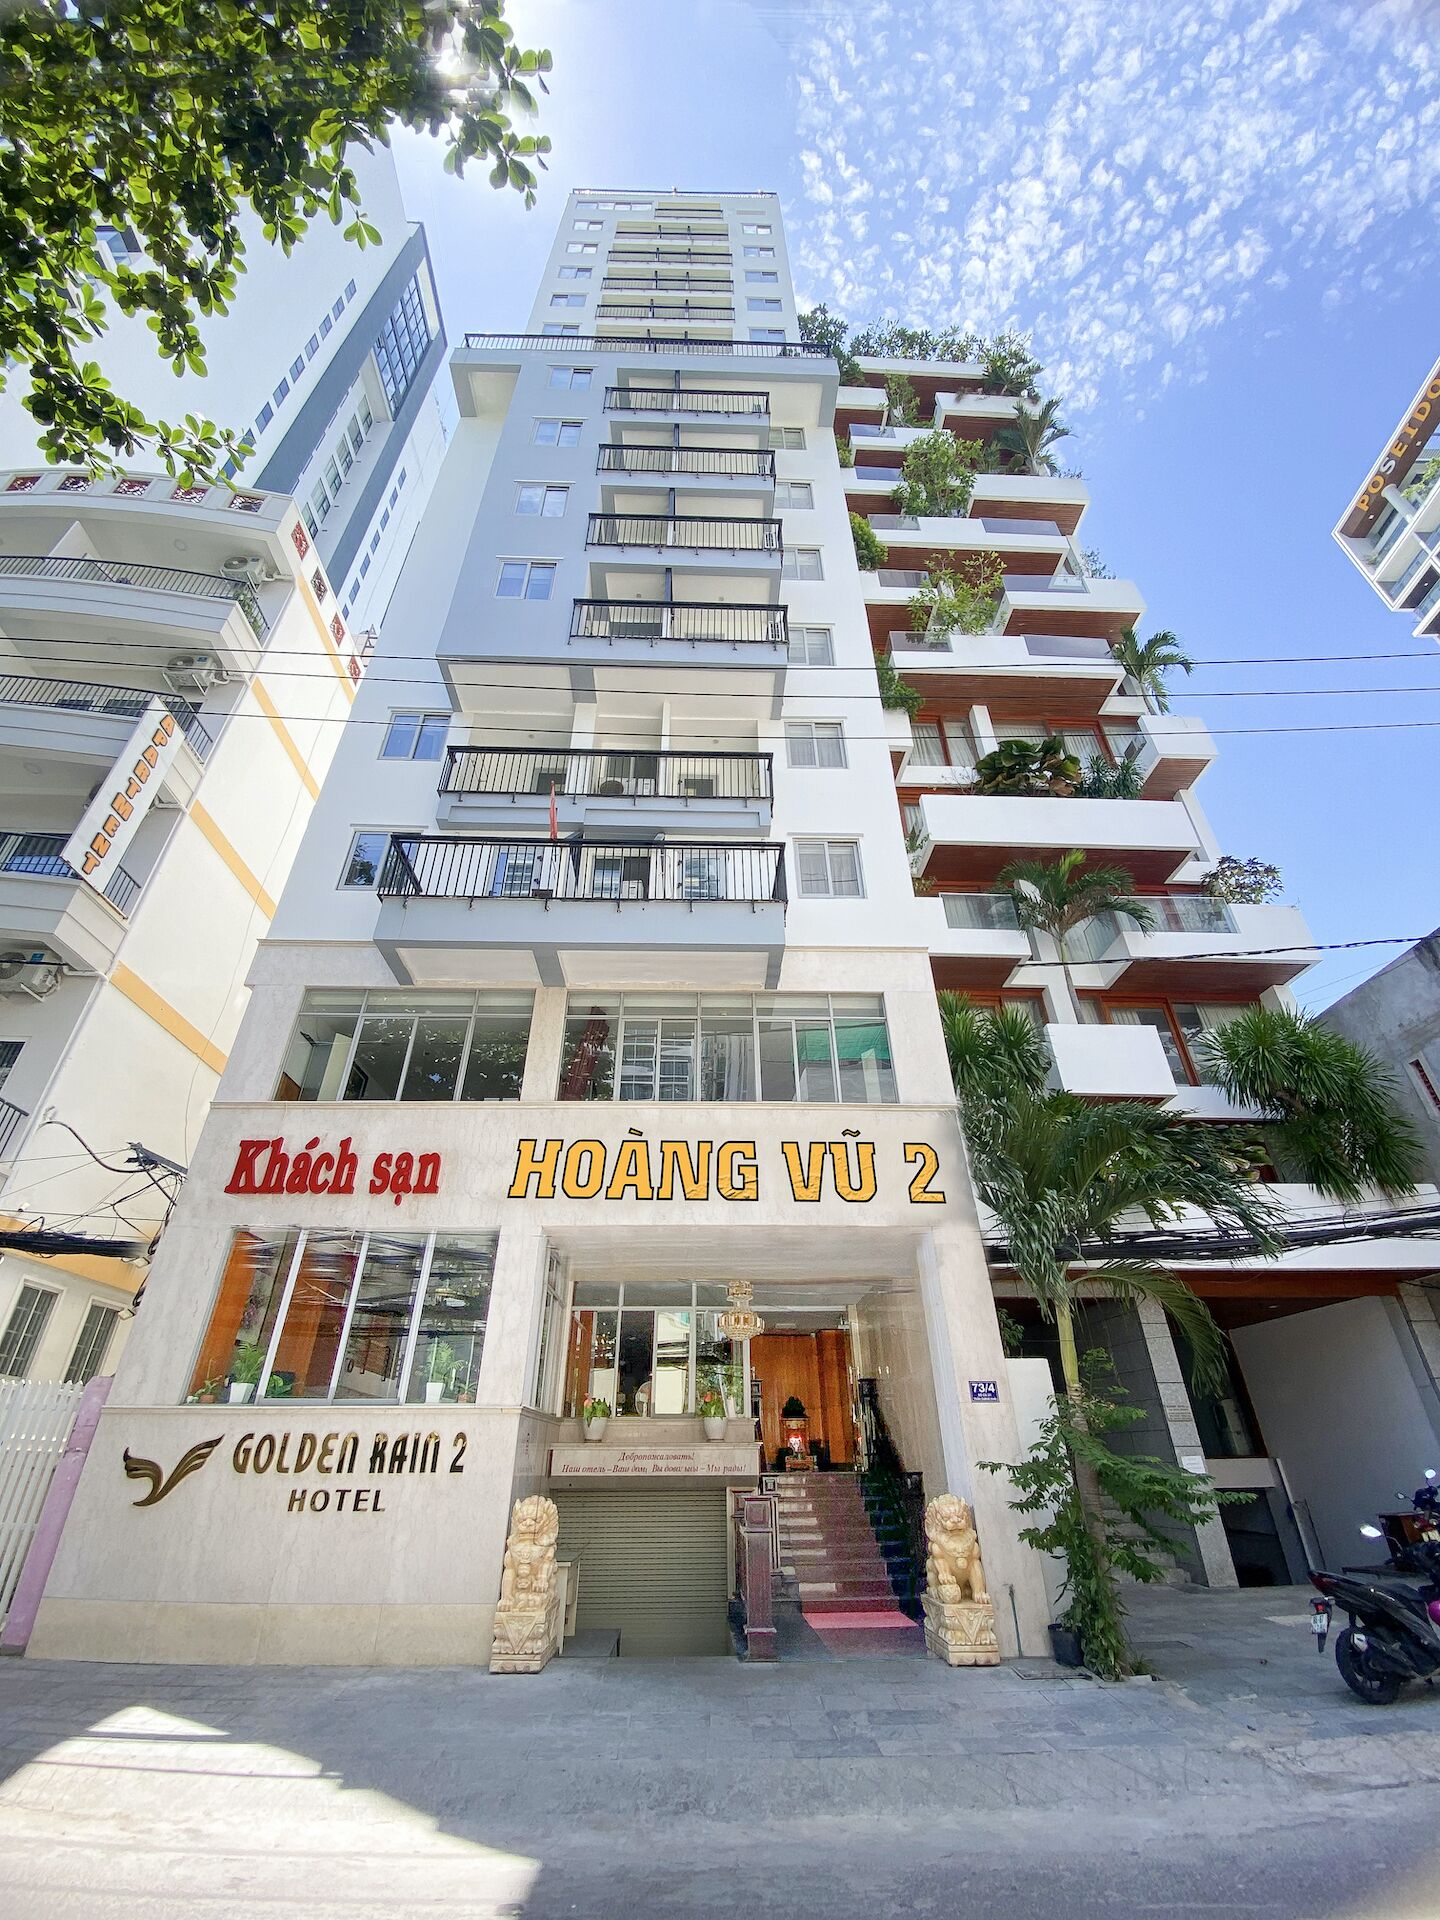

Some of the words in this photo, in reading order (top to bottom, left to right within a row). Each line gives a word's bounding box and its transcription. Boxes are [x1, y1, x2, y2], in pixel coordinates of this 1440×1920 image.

[81, 714, 176, 875] APARTMENT
[224, 1136, 356, 1195] Khách
[369, 1147, 442, 1206] sạn
[508, 1128, 759, 1202] HOÀNG
[781, 1129, 878, 1203] VŨ
[904, 1142, 946, 1204] 2
[971, 1383, 996, 1394] 73/4
[233, 1432, 359, 1474] GOLDEN
[369, 1432, 440, 1474] RAIN
[449, 1432, 467, 1474] 2
[287, 1489, 386, 1513] HOTEL
